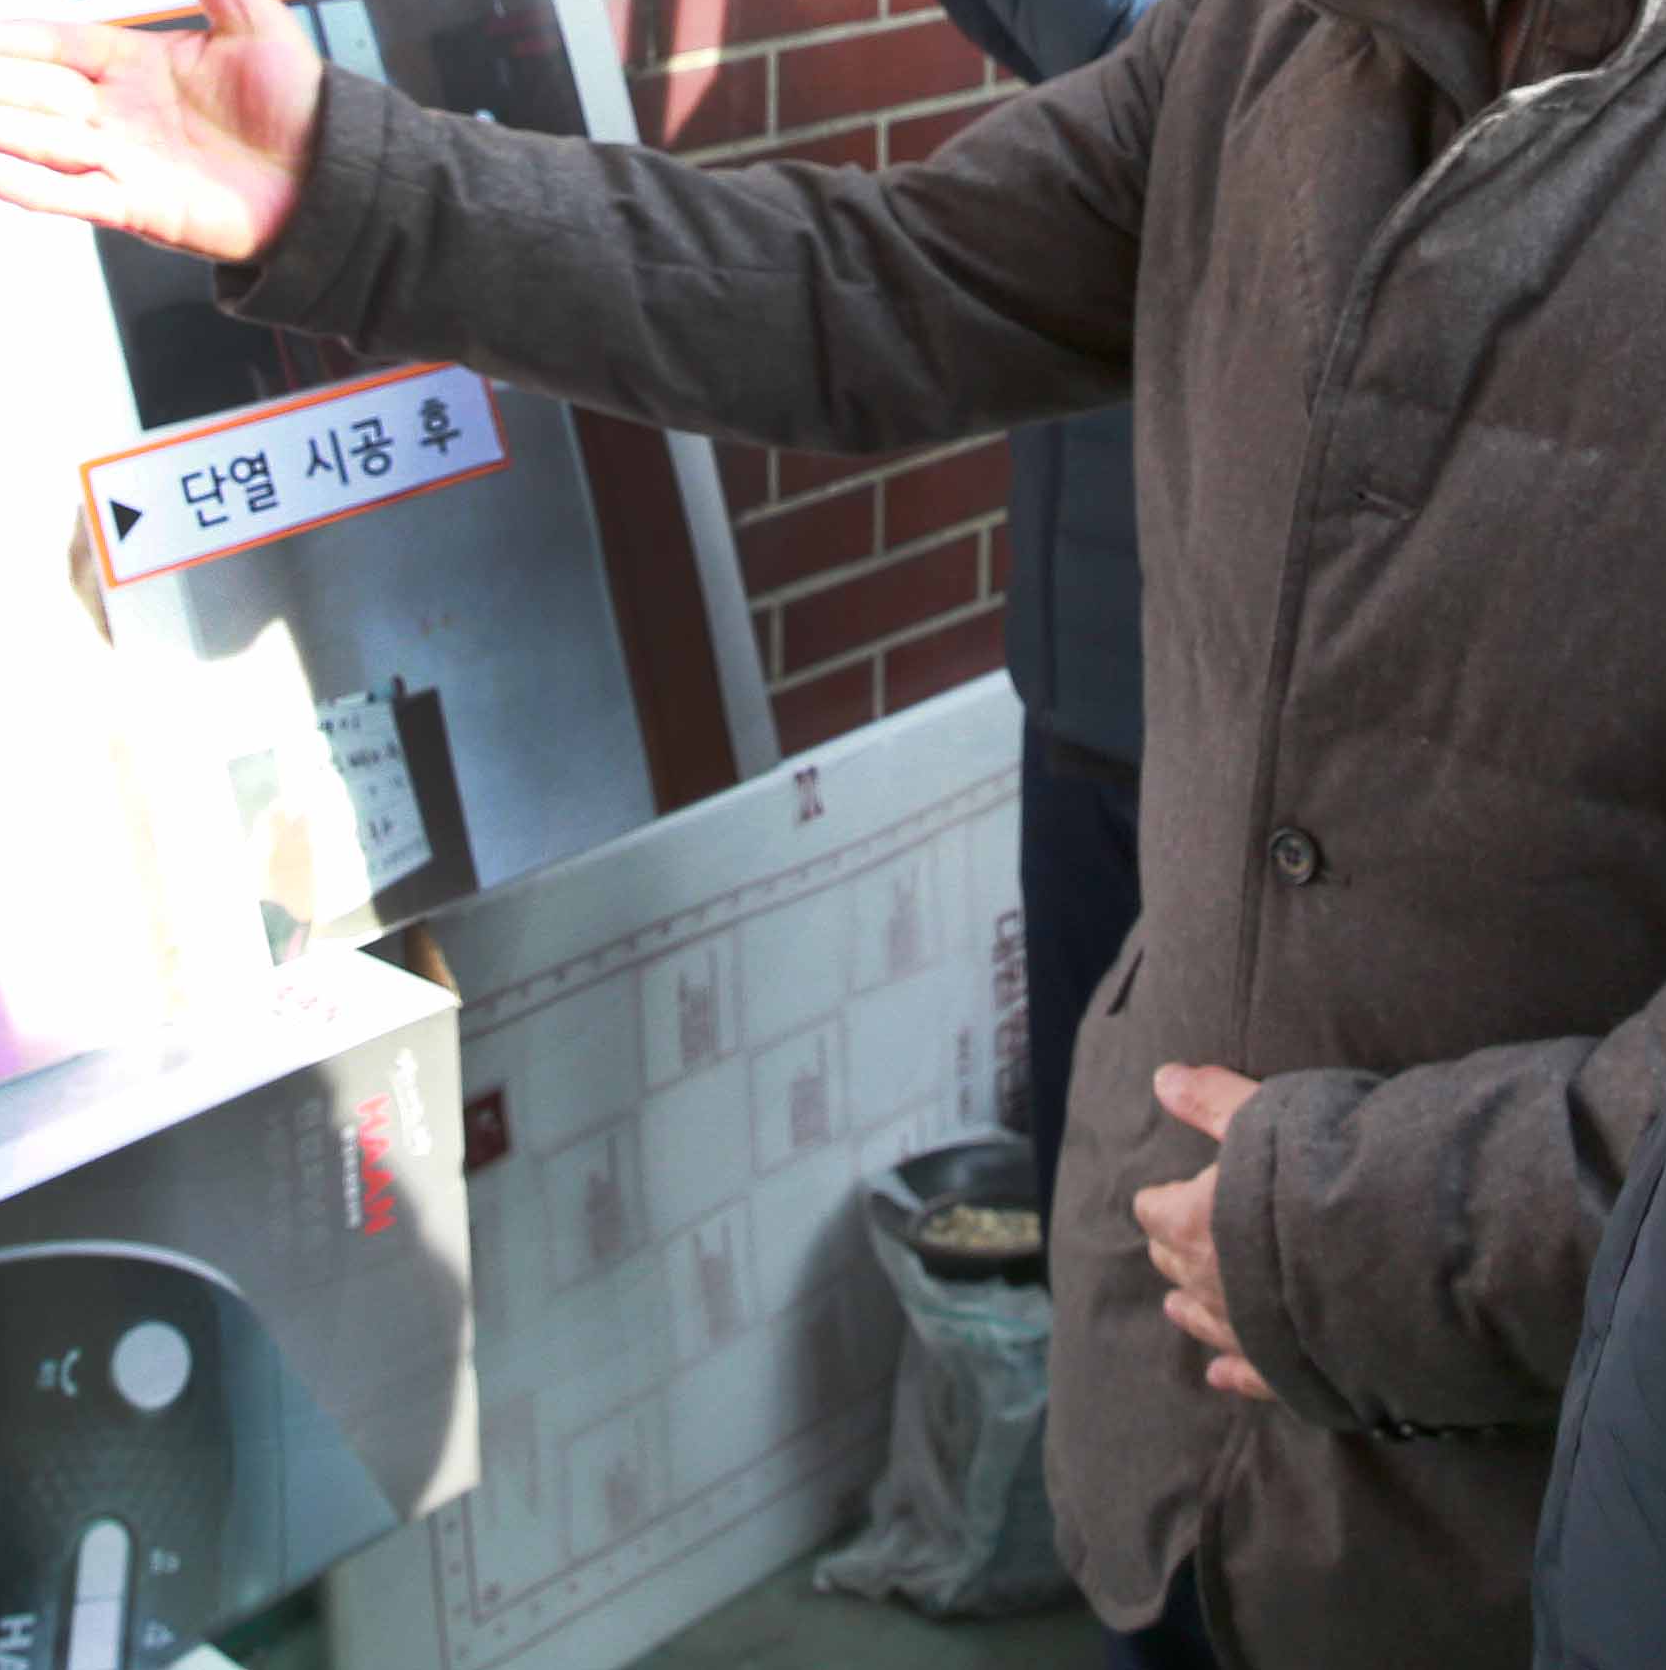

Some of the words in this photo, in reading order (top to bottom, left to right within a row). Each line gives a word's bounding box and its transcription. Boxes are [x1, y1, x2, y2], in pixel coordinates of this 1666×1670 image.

[181, 450, 280, 529] 단열
[305, 415, 394, 487] 시공
[418, 396, 461, 455] 후
